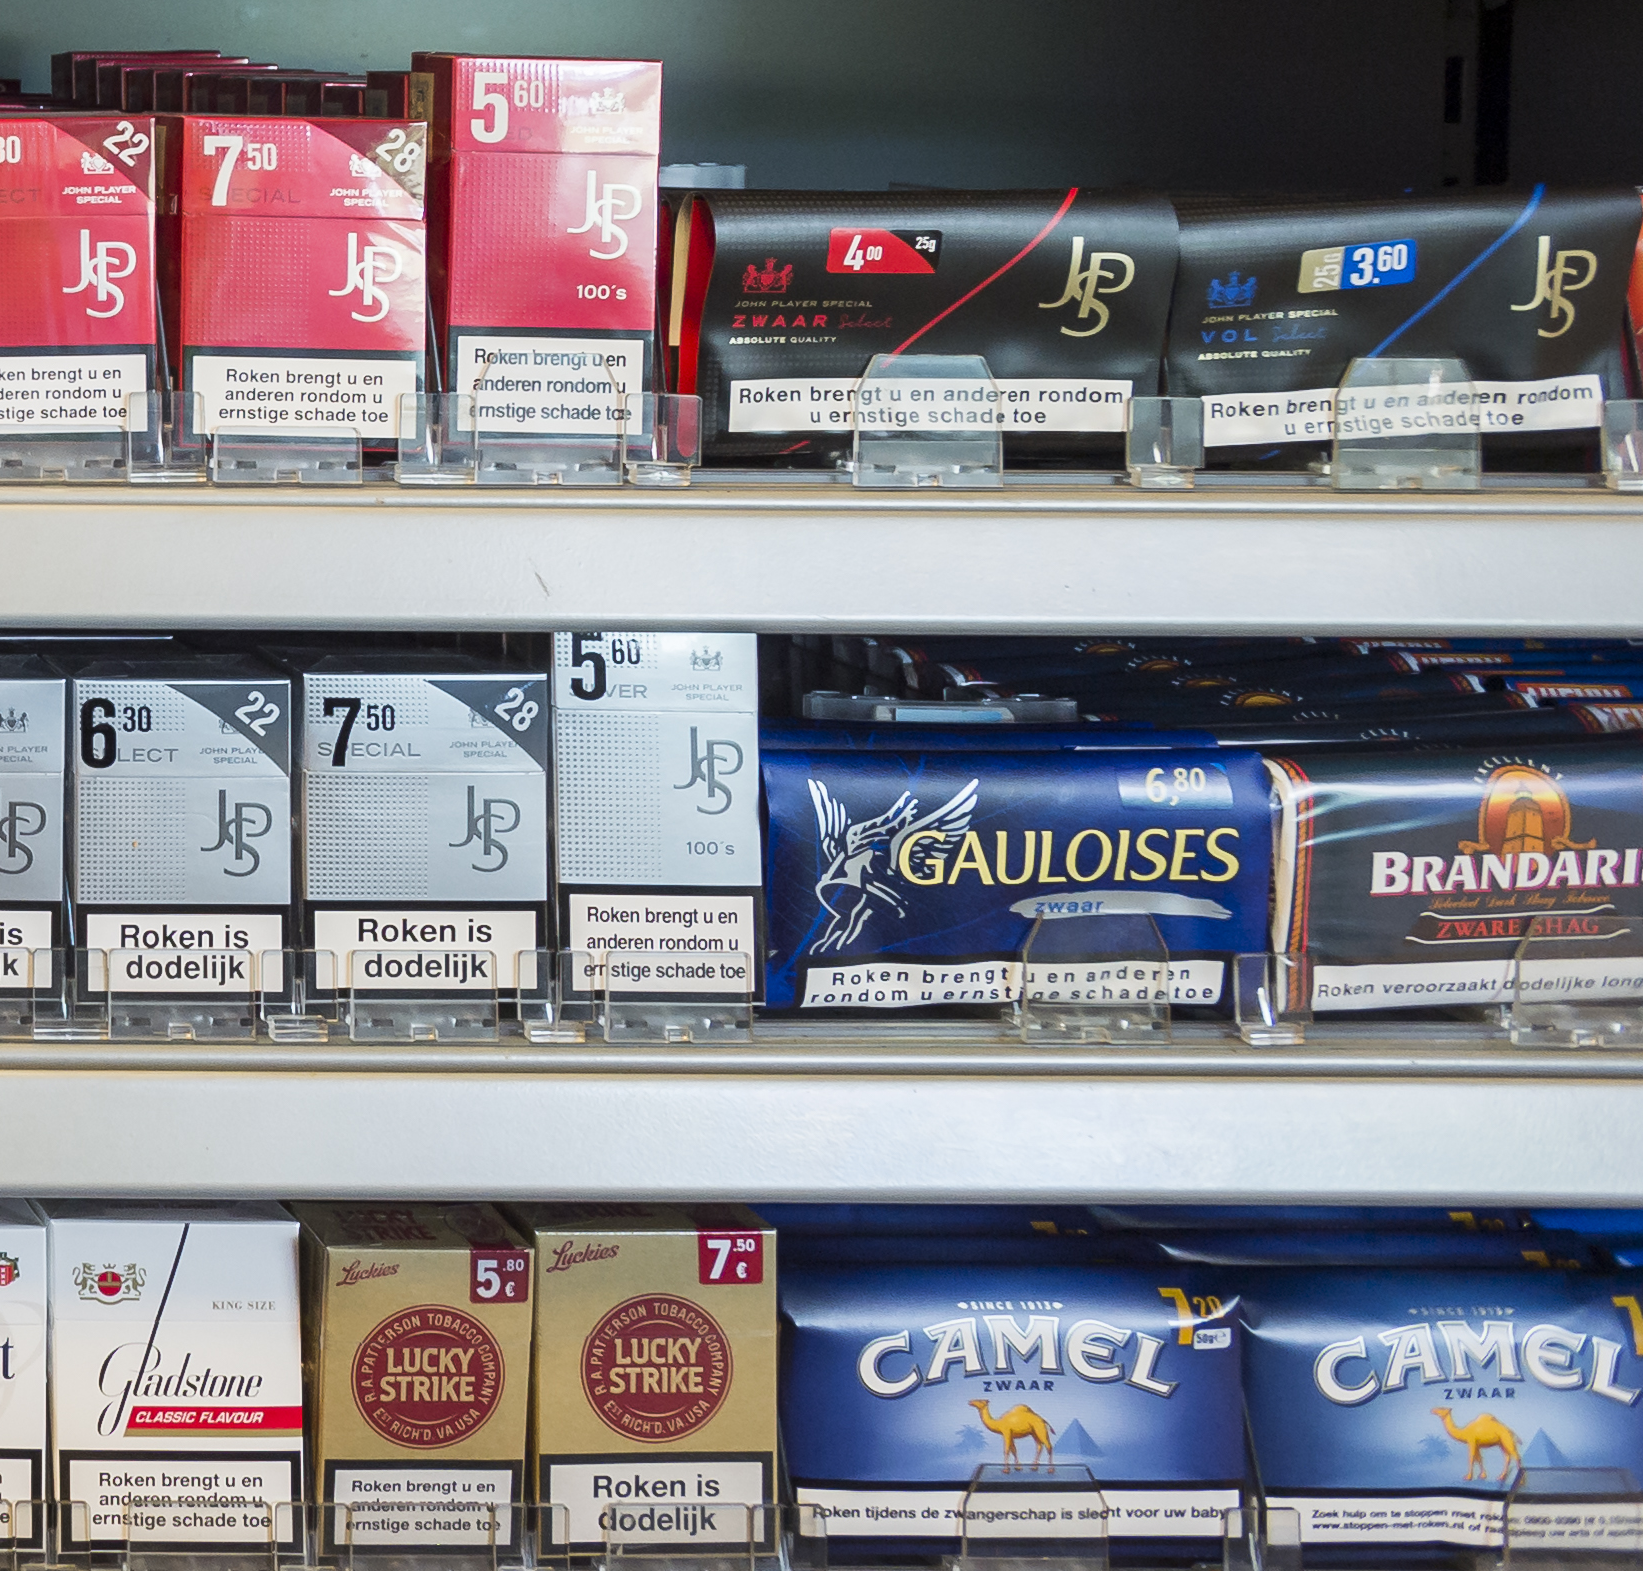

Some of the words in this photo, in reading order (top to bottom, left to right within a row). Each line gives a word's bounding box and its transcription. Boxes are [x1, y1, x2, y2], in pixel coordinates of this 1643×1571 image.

[733, 314, 827, 327] ZWAAR
[1202, 330, 1258, 344] VOL
[233, 690, 281, 736] 22
[899, 828, 1241, 884] GAULOISES
[1370, 849, 1643, 897] BRANDARI
[1035, 896, 1103, 915] zwaar
[1436, 918, 1520, 938] ZWARE
[1318, 981, 1377, 998] Roken
[1383, 975, 1498, 993] veroorzaakt
[547, 1241, 620, 1272] Luckies
[212, 1301, 241, 1311] KING
[247, 1301, 276, 1310] SIZE
[616, 1338, 703, 1364] LUCKY
[858, 1315, 1180, 1396] CAMEL
[610, 1366, 703, 1394] STRIKE
[983, 1380, 1054, 1392] ZWAAR
[136, 1411, 195, 1424] CLASSIC
[198, 1411, 263, 1424] FLAVOUR
[865, 1506, 917, 1521] tijdens
[921, 1507, 940, 1519] de
